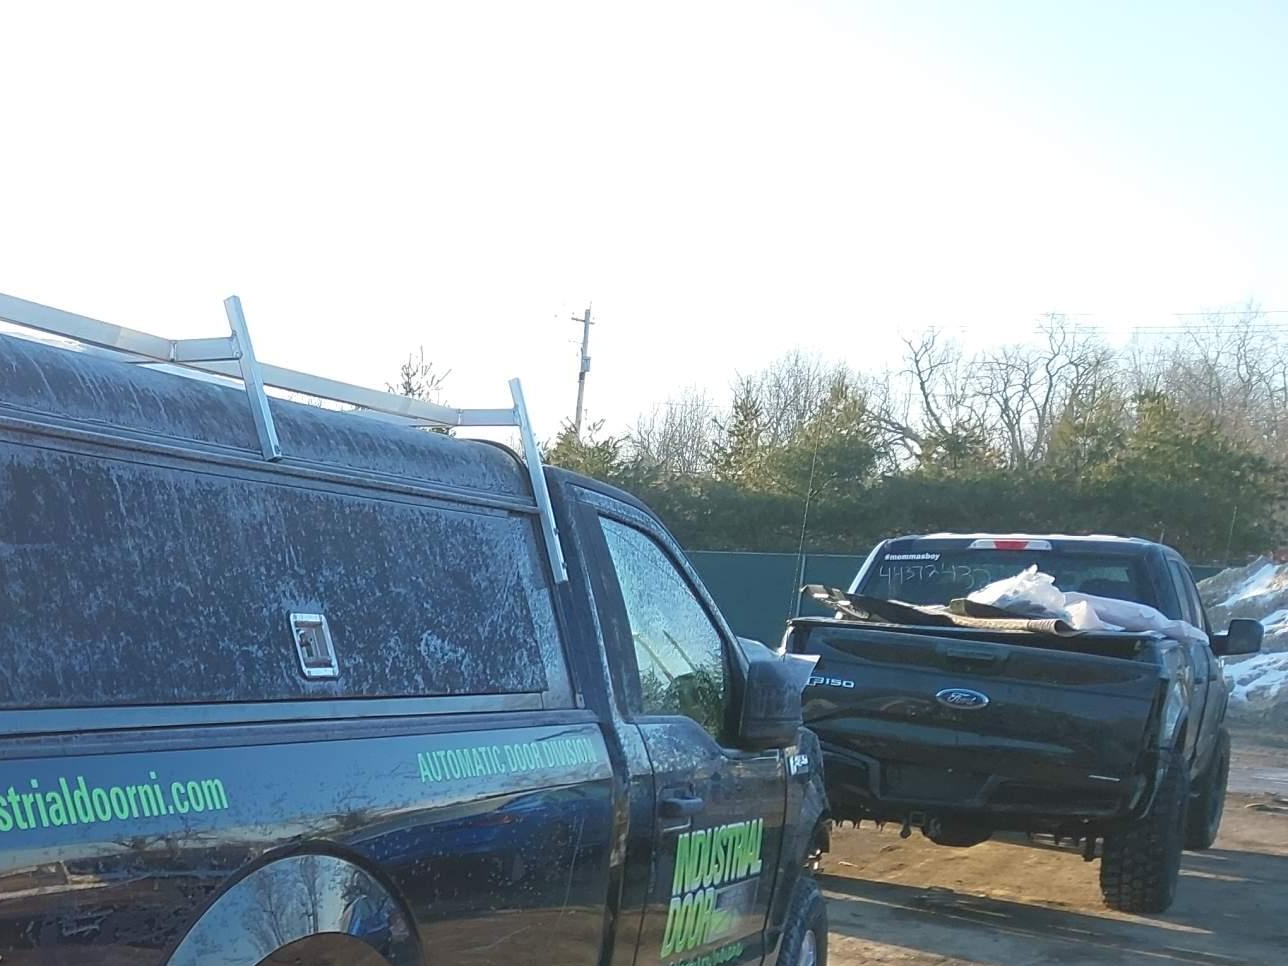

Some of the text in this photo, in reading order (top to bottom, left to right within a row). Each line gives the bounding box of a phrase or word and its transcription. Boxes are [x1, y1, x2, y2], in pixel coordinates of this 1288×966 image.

[417, 737, 598, 783] AUTOMATIC DOOR DIVISION
[672, 818, 764, 896] INDUSTRIAL
[661, 887, 719, 958] DOOR
